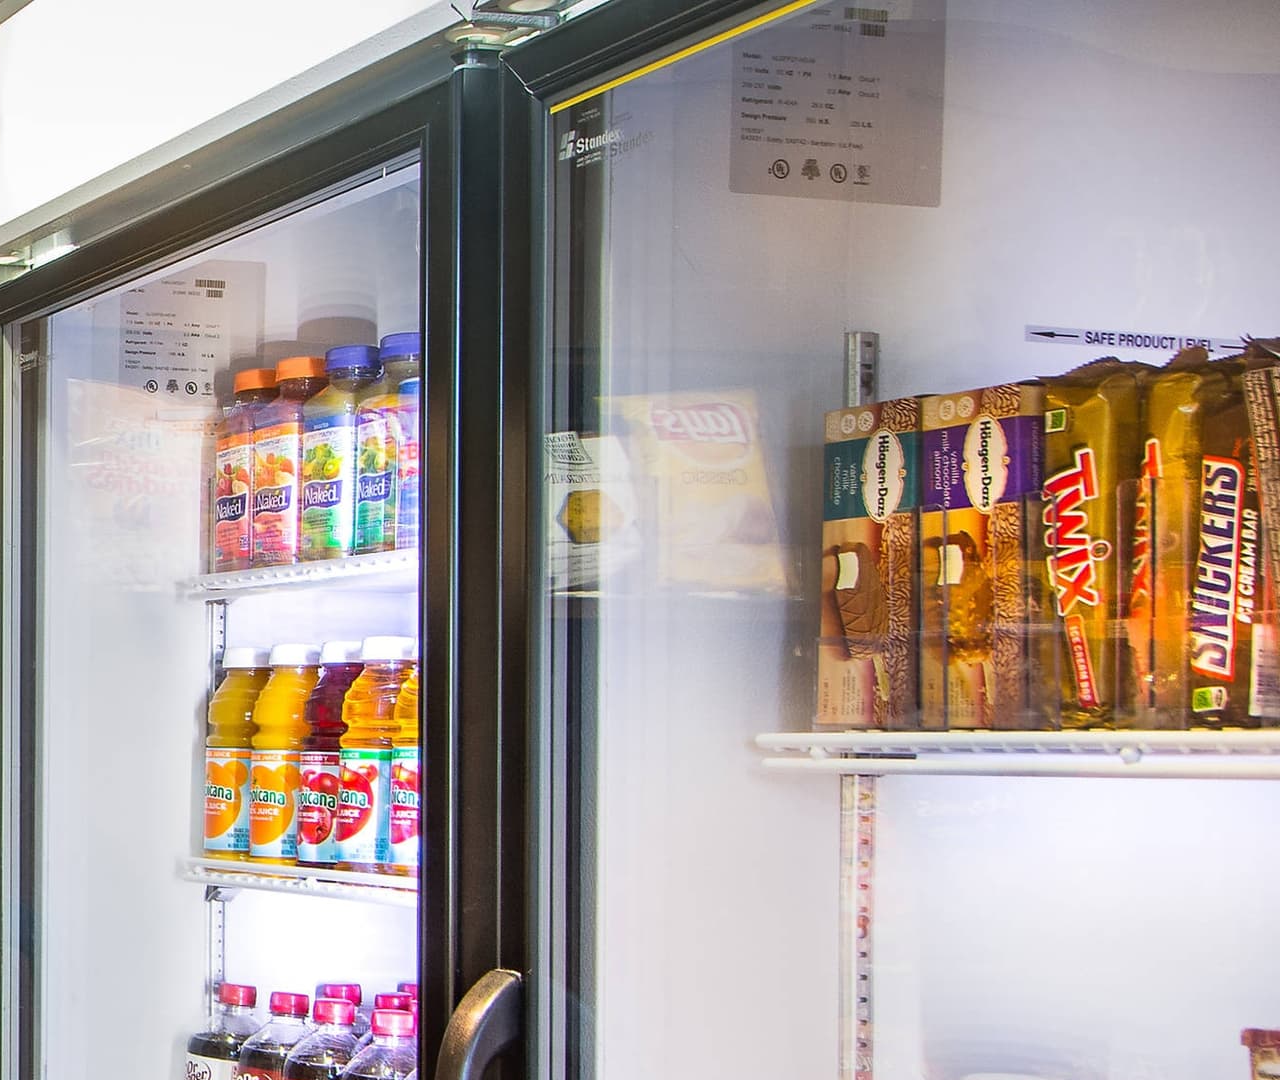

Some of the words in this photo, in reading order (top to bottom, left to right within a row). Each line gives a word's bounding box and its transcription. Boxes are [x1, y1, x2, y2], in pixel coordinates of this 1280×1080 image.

[1084, 331, 1115, 346] SAFE
[1118, 333, 1175, 350] PRODUCT
[849, 463, 857, 495] vanilla
[934, 451, 942, 490] almond
[1042, 449, 1111, 616] TWIX
[1243, 509, 1259, 544] BAR
[1192, 463, 1239, 669] SNICKERS
[1240, 548, 1257, 596] CREAM
[1070, 625, 1081, 640] ICE
[1073, 643, 1089, 677] CREAM
[188, 1060, 198, 1073] Dr
